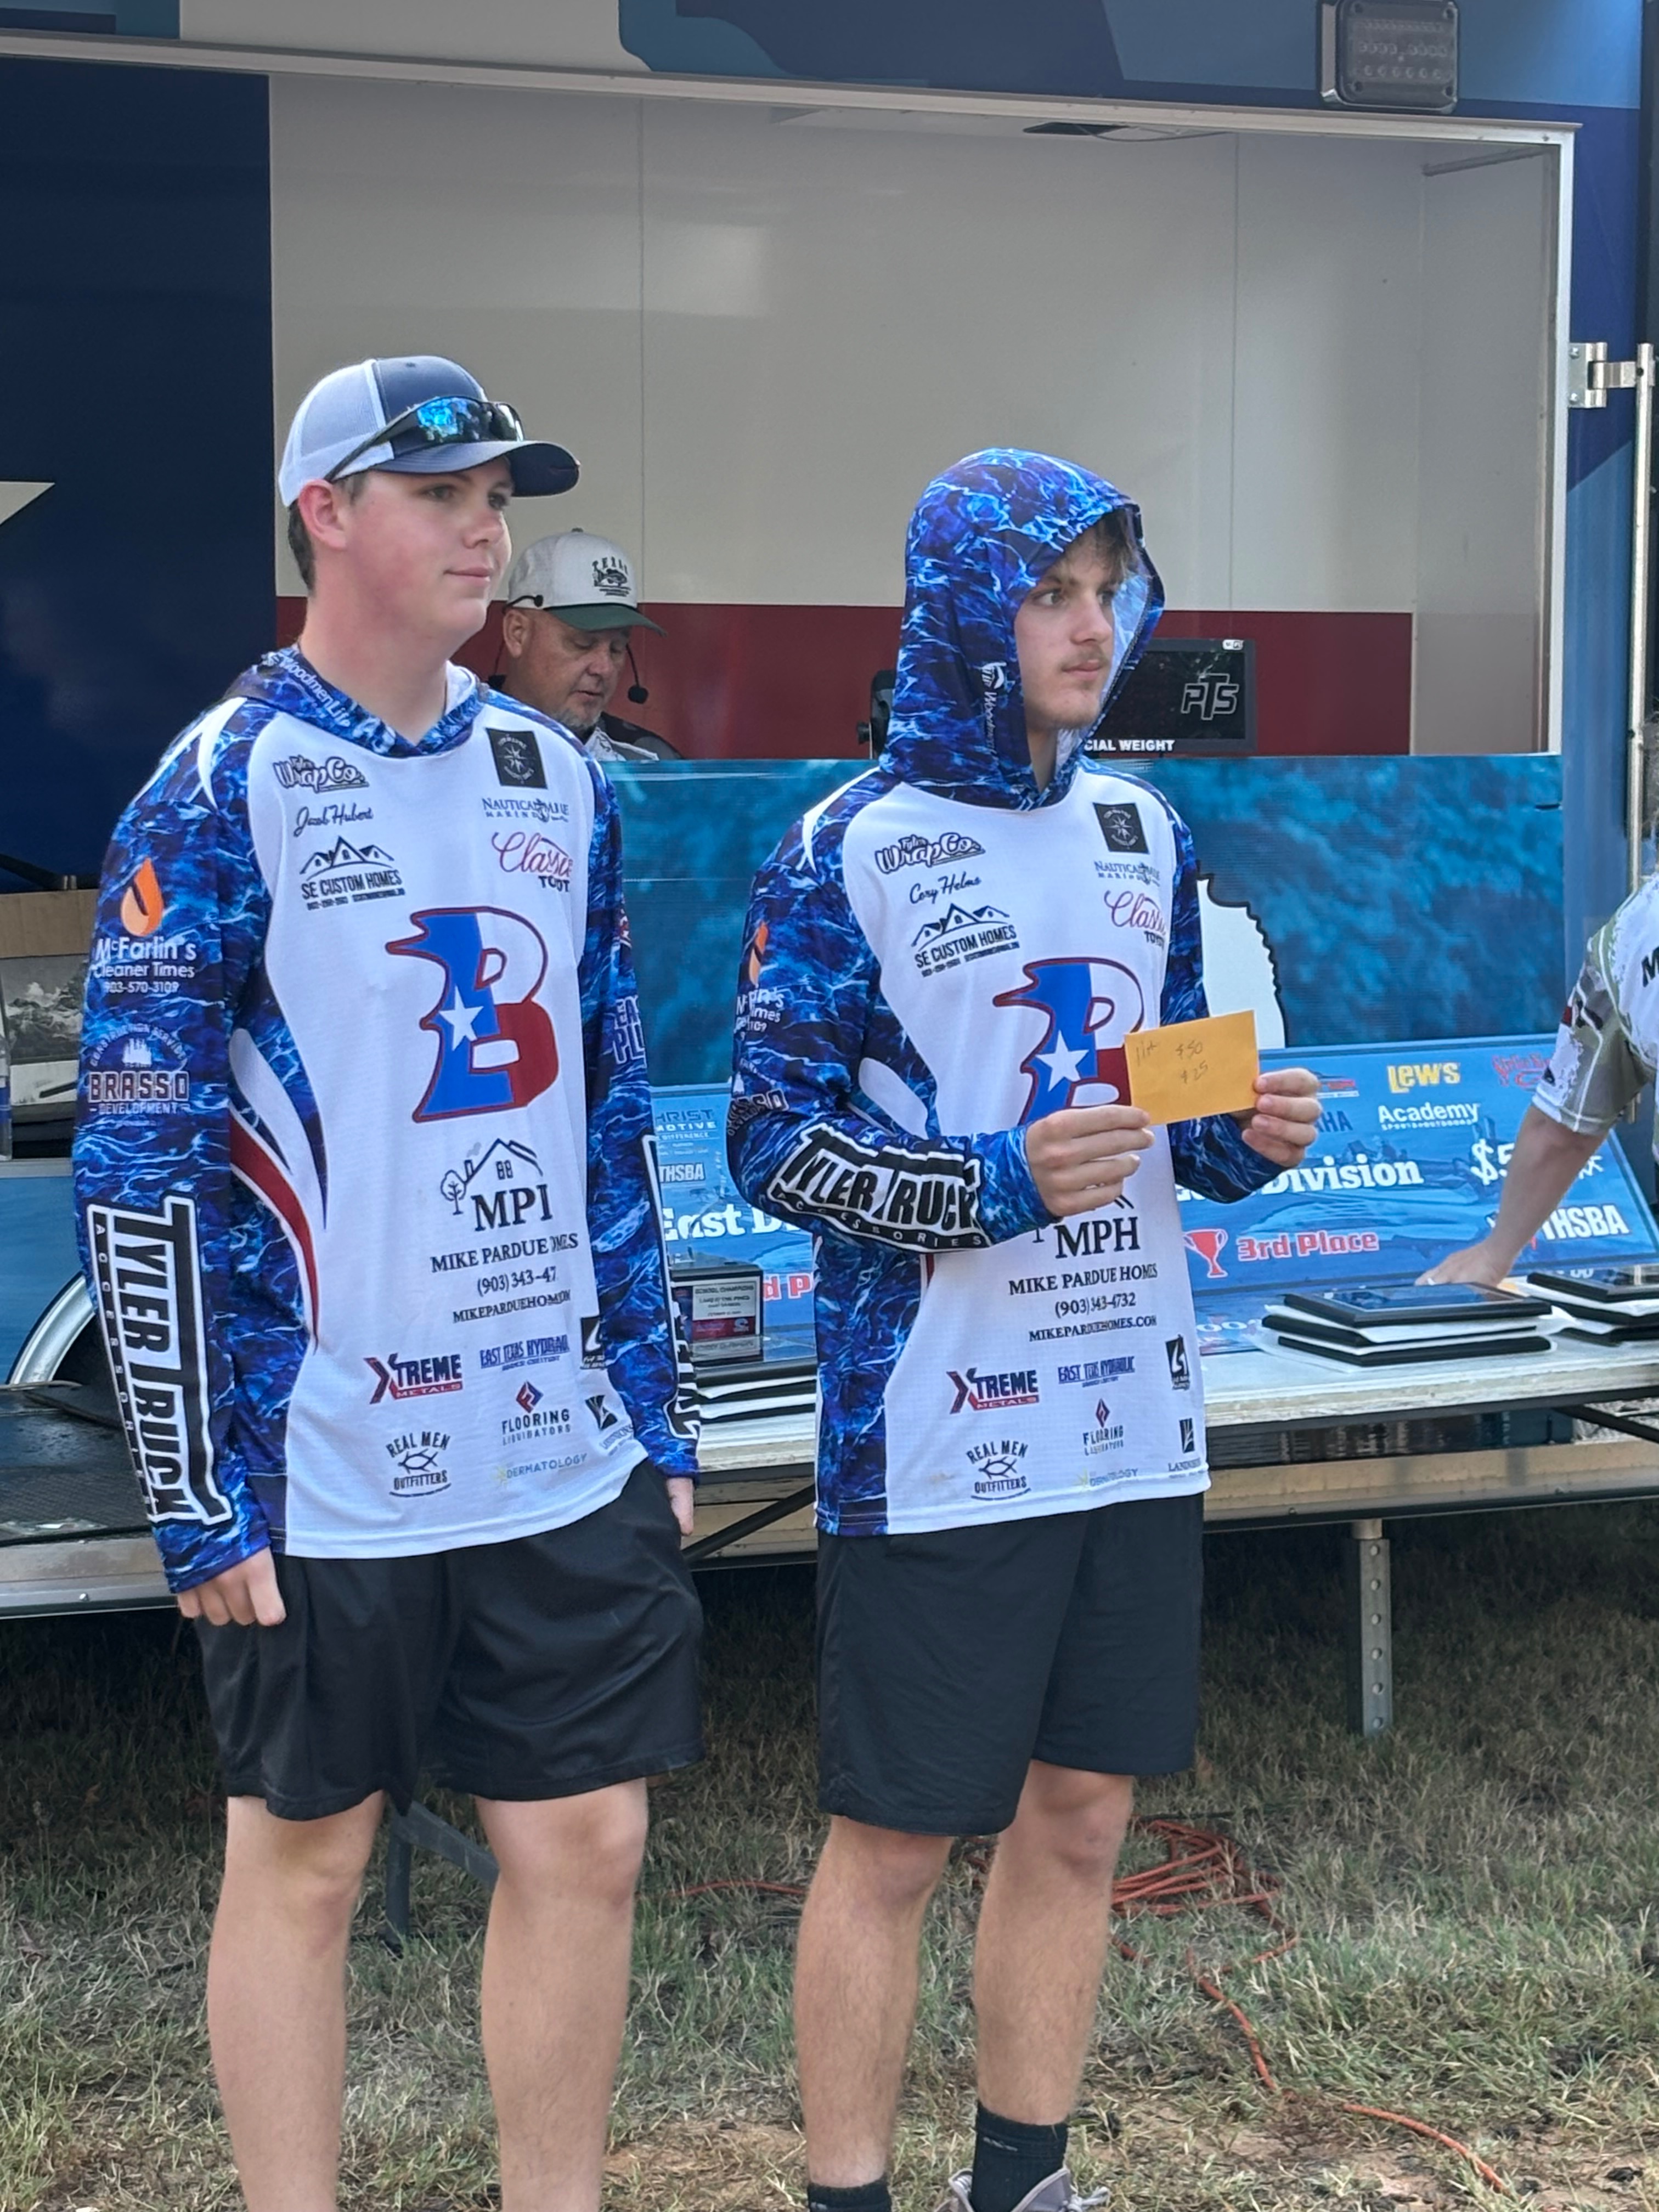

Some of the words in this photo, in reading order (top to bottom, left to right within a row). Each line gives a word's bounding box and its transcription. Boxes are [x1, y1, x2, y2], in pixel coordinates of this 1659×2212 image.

[1181, 673, 1239, 720] PTS
[1084, 740, 1116, 752] CIAL
[1119, 740, 1175, 752] WEIGHT
[874, 842, 943, 874] Wrap
[302, 882, 318, 900] SE
[319, 873, 366, 896] CUSTOM
[364, 869, 403, 889] HOMES
[915, 950, 932, 969] SE
[930, 934, 979, 962] CUSTOM
[977, 924, 1018, 947] HOMES
[92, 964, 149, 978] Cleaner
[153, 962, 195, 978] Times
[89, 1070, 190, 1103] BRASSO
[98, 1102, 178, 1115] DEVELOPMENT
[656, 1109, 713, 1122] HRIST
[1378, 1102, 1479, 1124] Academy
[659, 1163, 705, 1183] THSBA
[1263, 1154, 1424, 1195] Division
[662, 1203, 746, 1241] East
[1541, 1205, 1630, 1240] THSBA
[1053, 1216, 1141, 1259] MPH
[1237, 1232, 1291, 1261] 3rd
[1296, 1230, 1379, 1257] Place
[430, 1250, 479, 1273] MIKE
[482, 1238, 549, 1265] PARDUE
[477, 1273, 510, 1297] (903)
[1008, 1275, 1058, 1295] MIKE
[1061, 1267, 1117, 1289] PARDUE
[1054, 1298, 1090, 1318] (903)
[479, 1346, 501, 1368] EAST
[363, 1352, 463, 1405] XTREME
[396, 1383, 462, 1398] METALS
[945, 1367, 1040, 1415] XTREME
[976, 1396, 1037, 1409] METALS
[501, 1408, 571, 1435] FLOORING
[502, 1424, 571, 1446] LIQUIDATORS
[385, 1432, 417, 1458] REAL
[421, 1431, 451, 1451] MEN
[965, 1440, 998, 1464] REAL
[1001, 1440, 1029, 1459] MEN
[393, 1469, 448, 1491] OUTFITTERS
[506, 1453, 588, 1480] DERMATOLOGY
[974, 1475, 1028, 1494] OUTFITTERS
